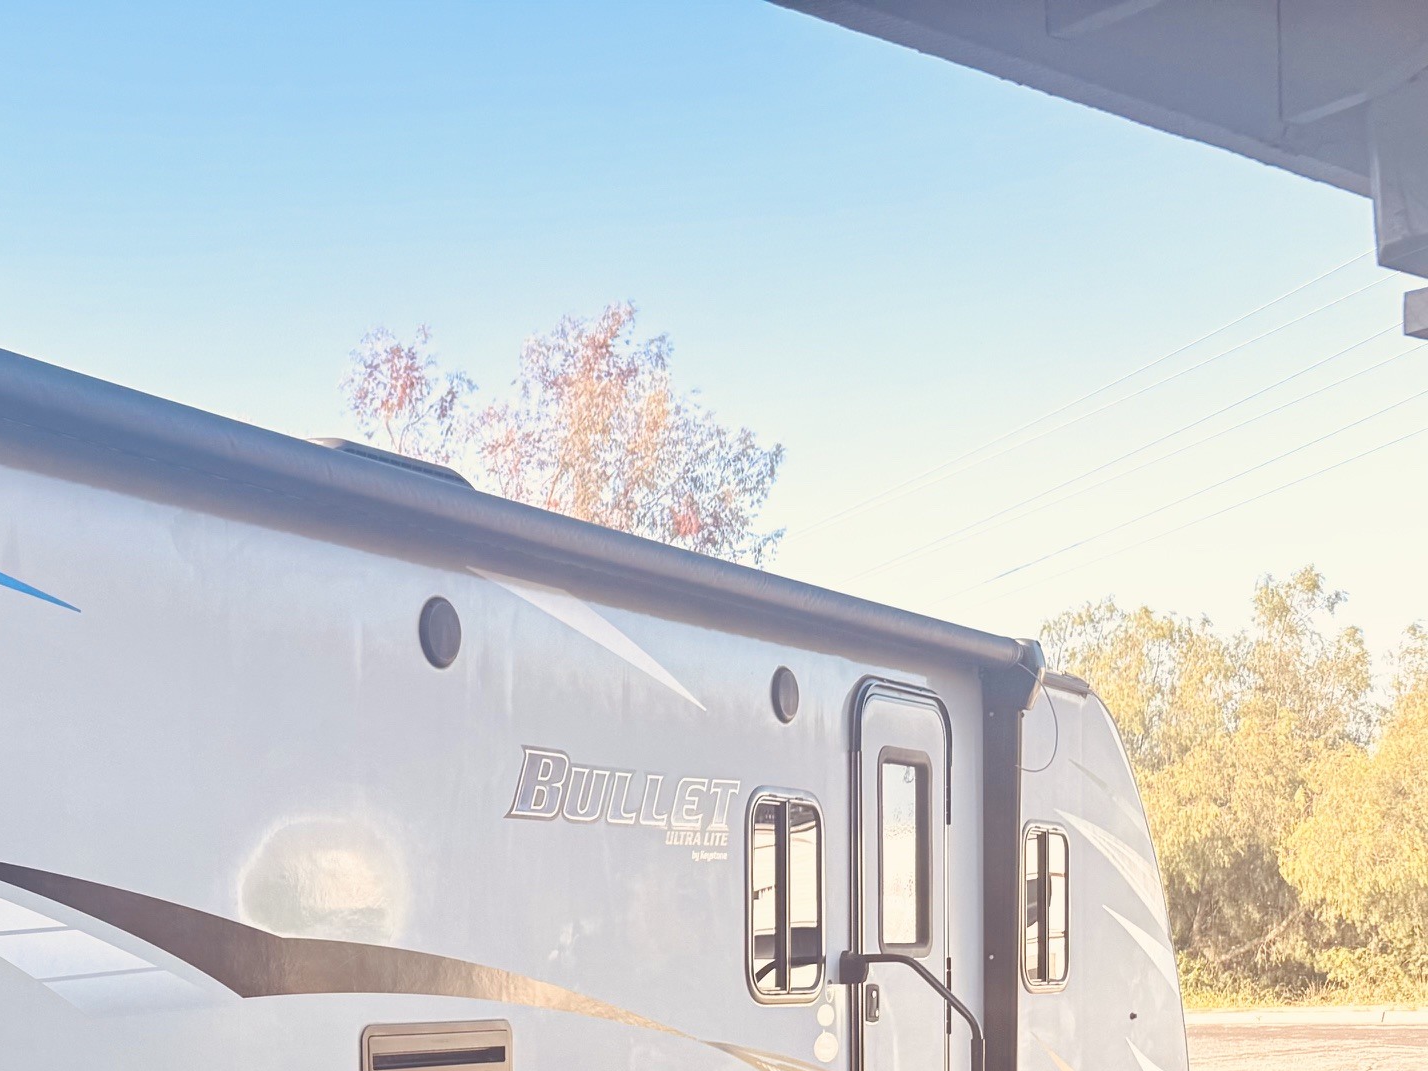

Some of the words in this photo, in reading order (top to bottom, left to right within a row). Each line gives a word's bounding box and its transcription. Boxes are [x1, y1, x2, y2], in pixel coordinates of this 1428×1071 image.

[503, 745, 741, 830] BULLET
[665, 831, 701, 846] ULTRA
[703, 832, 729, 846] LITE
